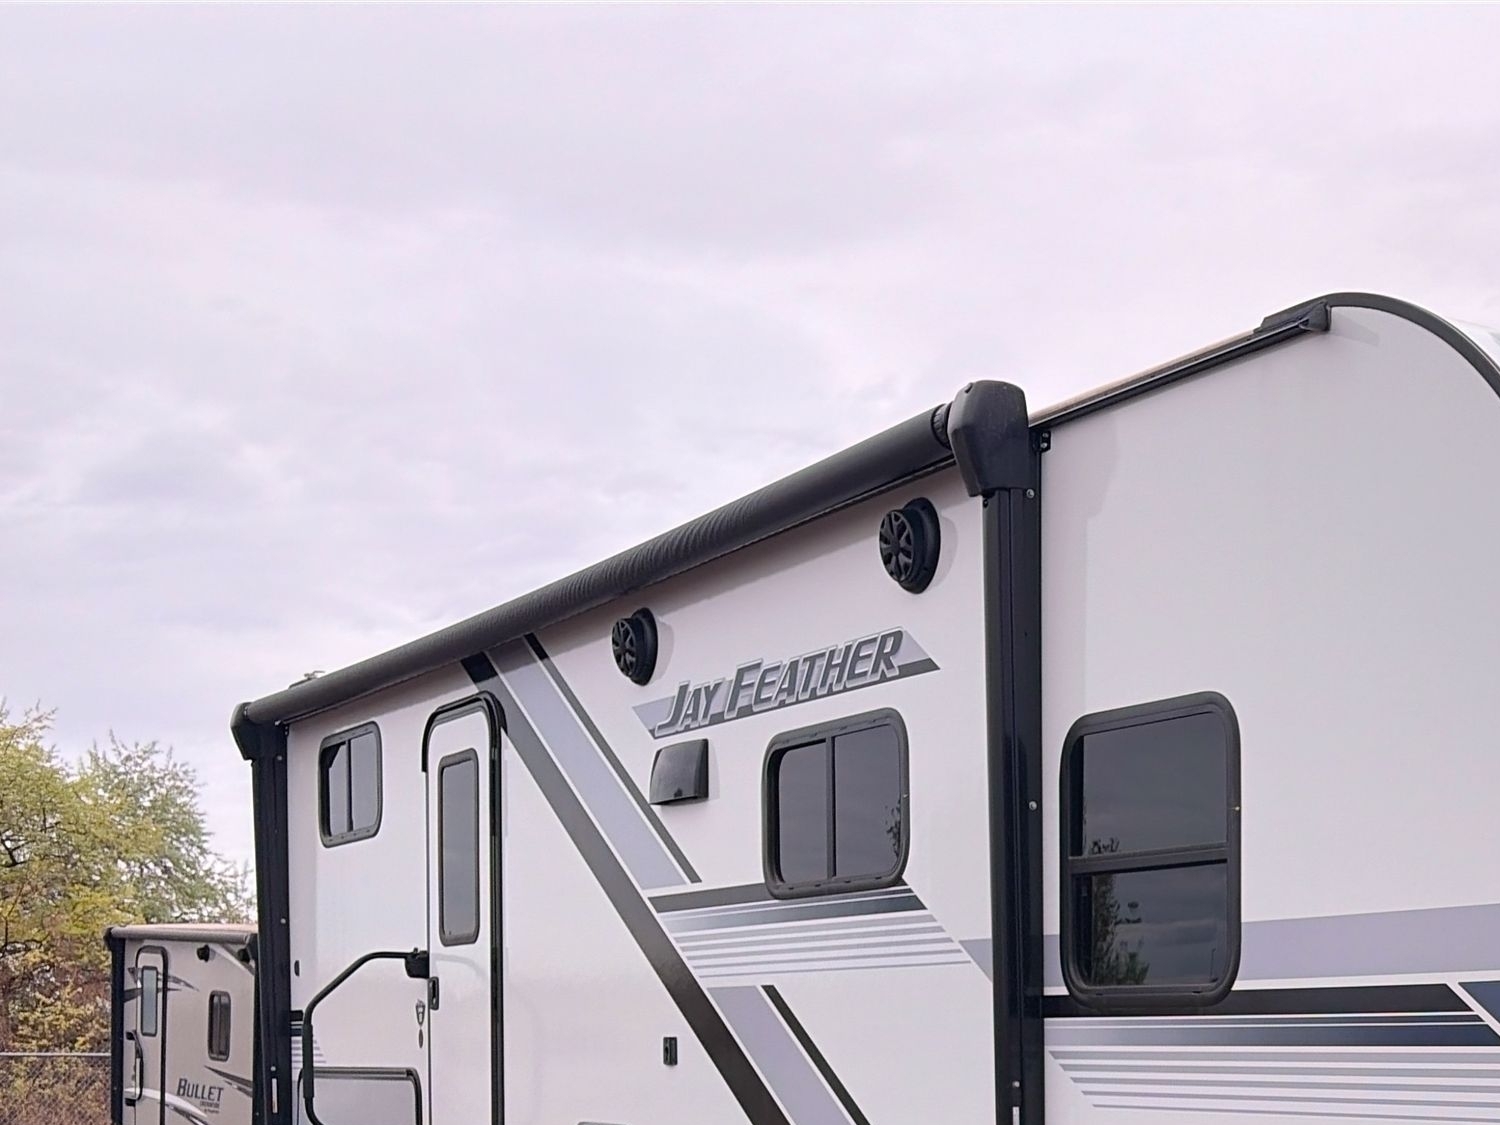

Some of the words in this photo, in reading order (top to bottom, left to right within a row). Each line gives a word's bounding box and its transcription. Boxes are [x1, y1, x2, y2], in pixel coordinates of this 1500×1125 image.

[655, 679, 725, 736] JAY
[725, 627, 904, 719] FEATHER
[177, 1078, 224, 1101] BULLET
